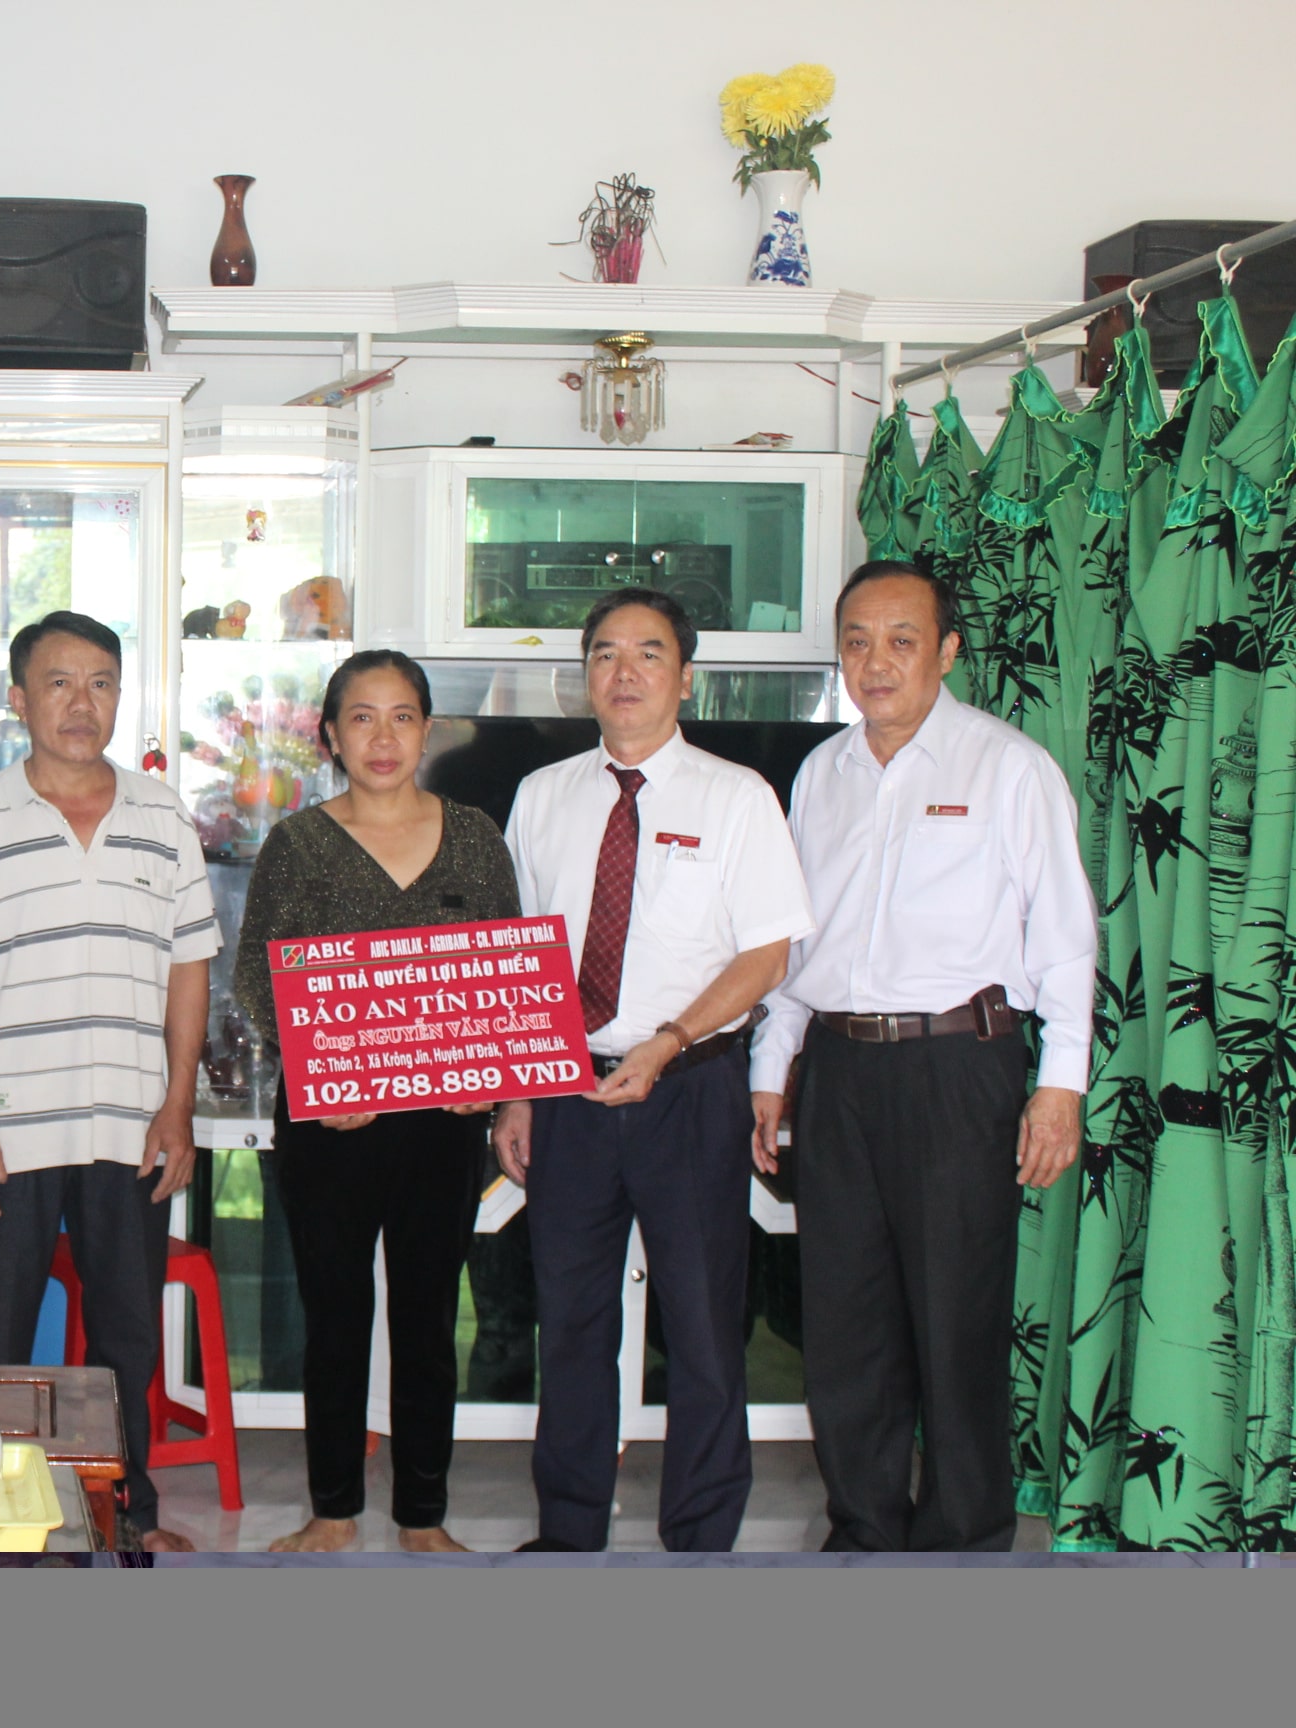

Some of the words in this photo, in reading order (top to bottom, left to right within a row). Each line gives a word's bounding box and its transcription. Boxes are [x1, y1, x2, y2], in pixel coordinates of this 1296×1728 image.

[306, 939, 355, 960] ABIC
[370, 940, 390, 958] ABIC
[430, 932, 471, 953] AGRIBANK
[307, 975, 334, 993] CHI
[337, 968, 369, 990] TRẢ
[431, 961, 457, 983] LỢI
[460, 957, 494, 979] BẢO
[497, 952, 541, 975] HIỂM
[290, 998, 357, 1027] BẢO
[365, 997, 407, 1020] AN
[413, 988, 468, 1015] TÍN
[474, 983, 565, 1011] DỤNG
[313, 1029, 355, 1052] Ông:
[357, 1017, 444, 1046] NGUYỄN
[445, 1016, 490, 1038] VĂN
[492, 1010, 553, 1034] CẢNH
[307, 1058, 326, 1075] ĐC:
[327, 1056, 353, 1073] Thôn
[354, 1056, 364, 1073] 2,
[367, 1053, 381, 1069] Xã
[383, 1050, 413, 1070] Krông
[433, 1045, 464, 1066] Huyện
[505, 1037, 528, 1056] Tỉnh
[302, 1066, 502, 1107] 102.788.889
[510, 1059, 580, 1086] VND
